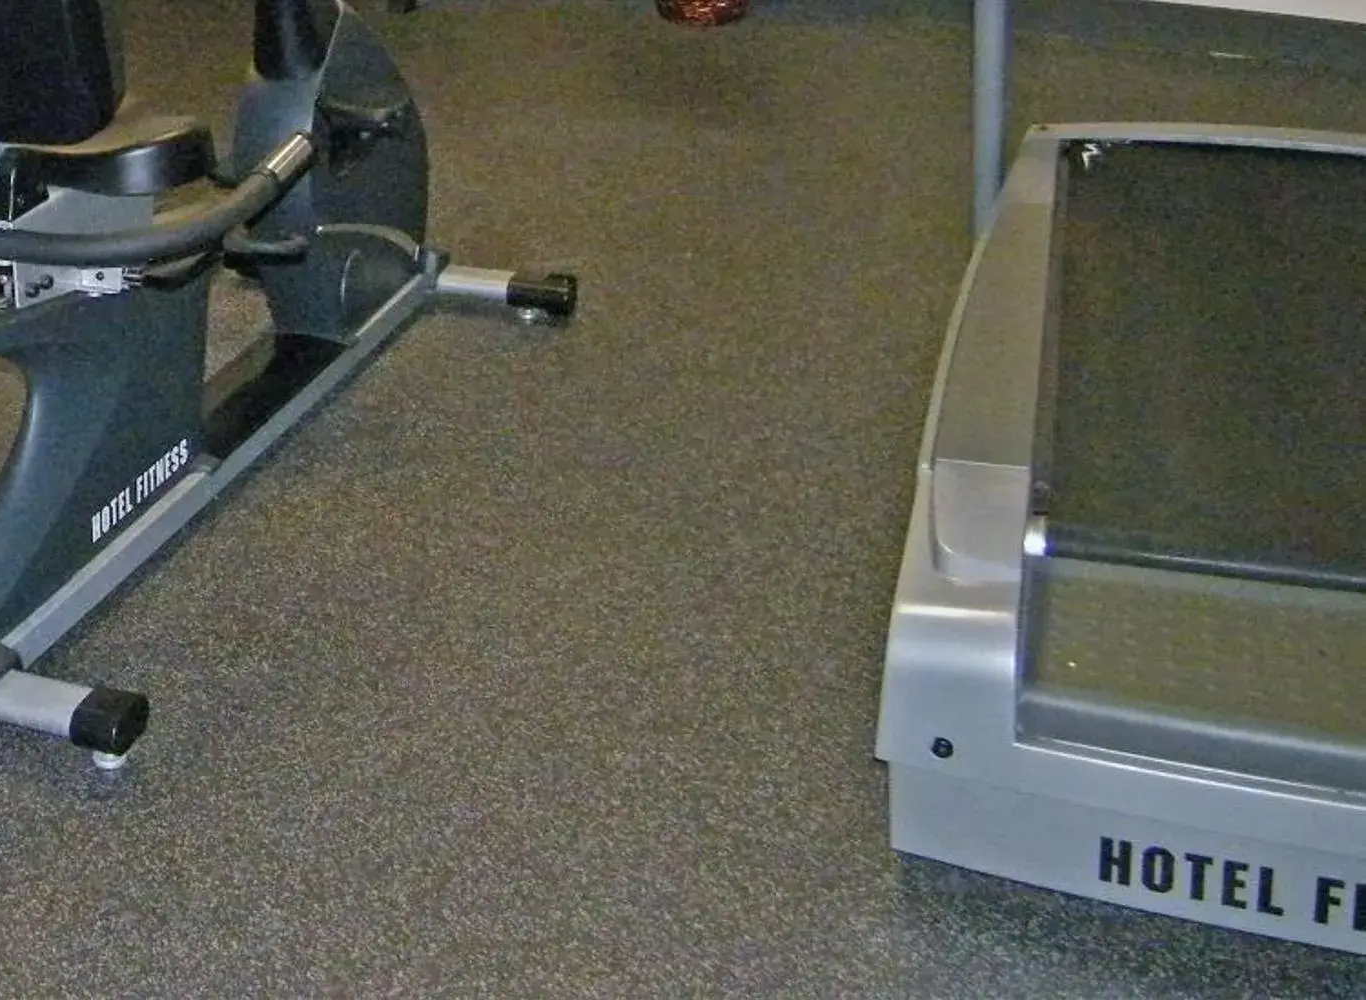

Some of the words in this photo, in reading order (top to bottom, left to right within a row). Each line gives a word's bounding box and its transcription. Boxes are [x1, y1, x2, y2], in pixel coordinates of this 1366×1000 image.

[91, 485, 134, 543] HOTEL
[136, 438, 189, 504] FITNESS
[1098, 836, 1285, 917] HOTEL
